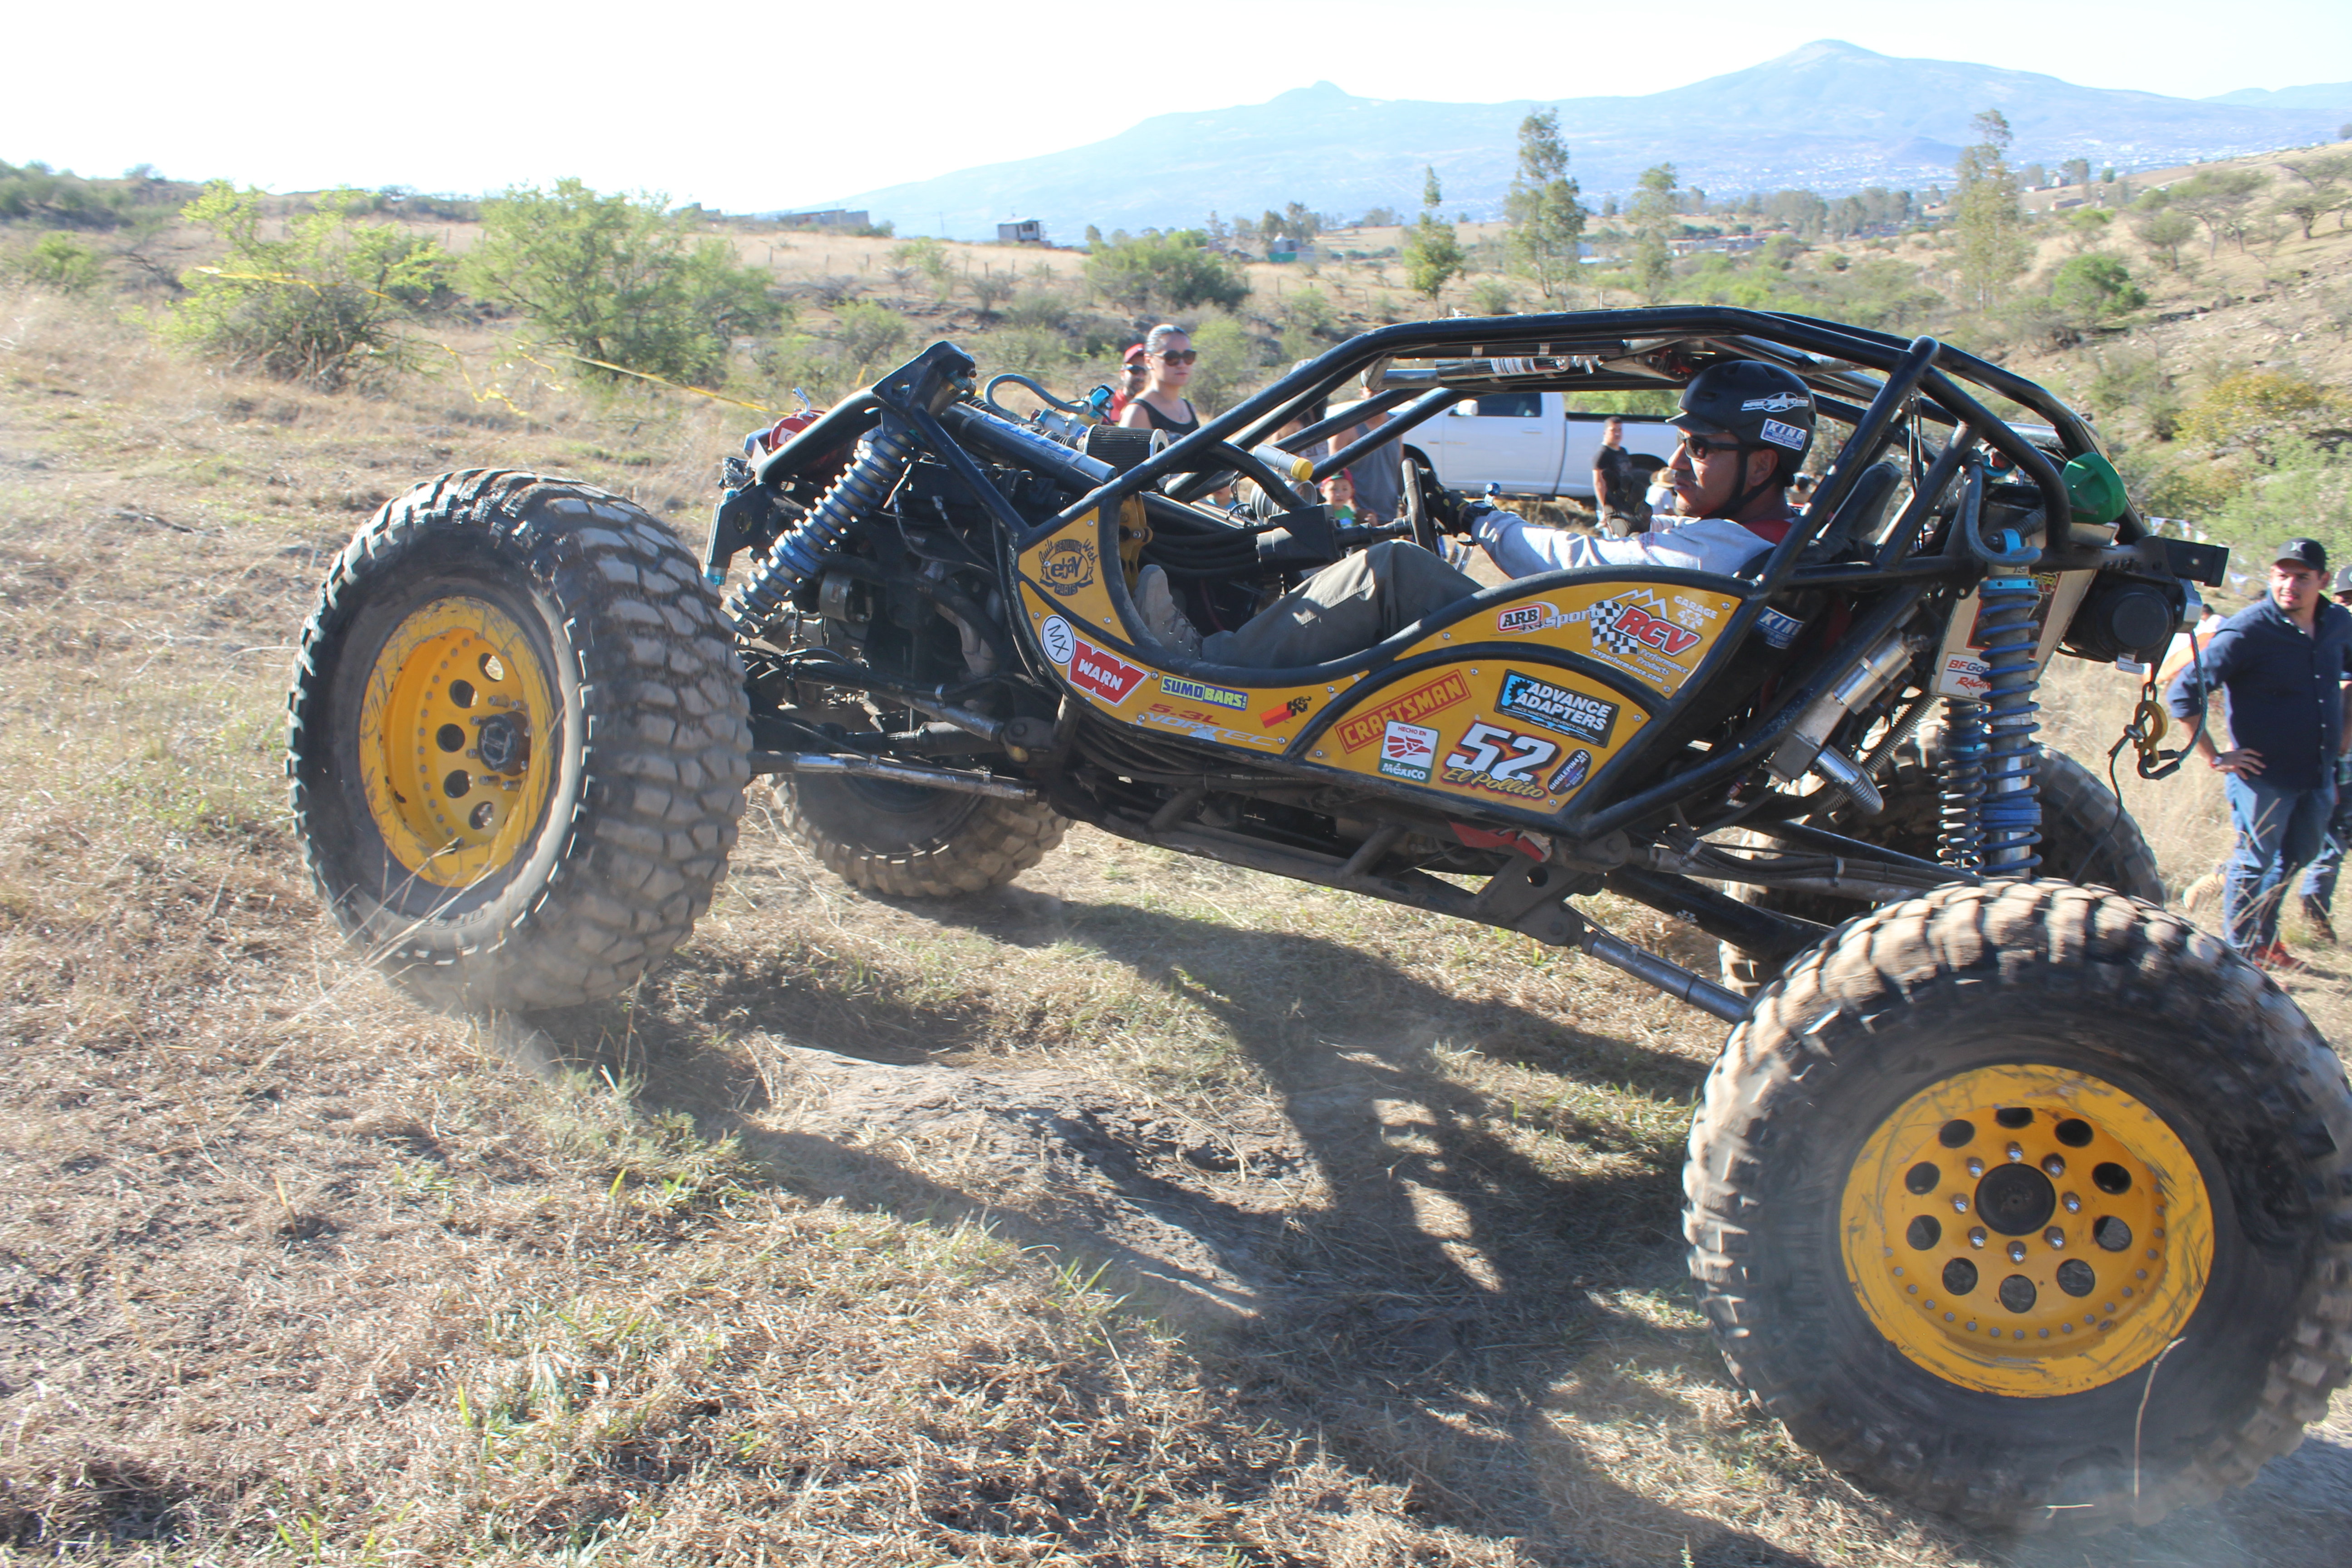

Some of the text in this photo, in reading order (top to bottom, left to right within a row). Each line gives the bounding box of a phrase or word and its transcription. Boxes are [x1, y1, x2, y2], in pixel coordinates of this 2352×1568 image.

[1768, 422, 1805, 440] KING
[1056, 584, 1077, 595] PARTS
[1502, 609, 1538, 627] ARB
[1674, 596, 1718, 619] GARAGE
[1048, 624, 1069, 657] MX
[1612, 605, 1701, 656] RCV
[1078, 658, 1123, 691] WARN
[1589, 648, 1664, 683] rcvperformance.com
[1636, 656, 1671, 676] Products
[1639, 648, 1689, 674] Performance
[1148, 703, 1220, 725] 5.3L
[1343, 677, 1463, 745] CRAFTSMAN
[1514, 693, 1607, 731] ADAPTERS
[1526, 682, 1612, 718] ADVANCE
[1398, 726, 1418, 735] HECHO
[1446, 722, 1556, 782] 52
[1442, 768, 1544, 798] El Pollito
